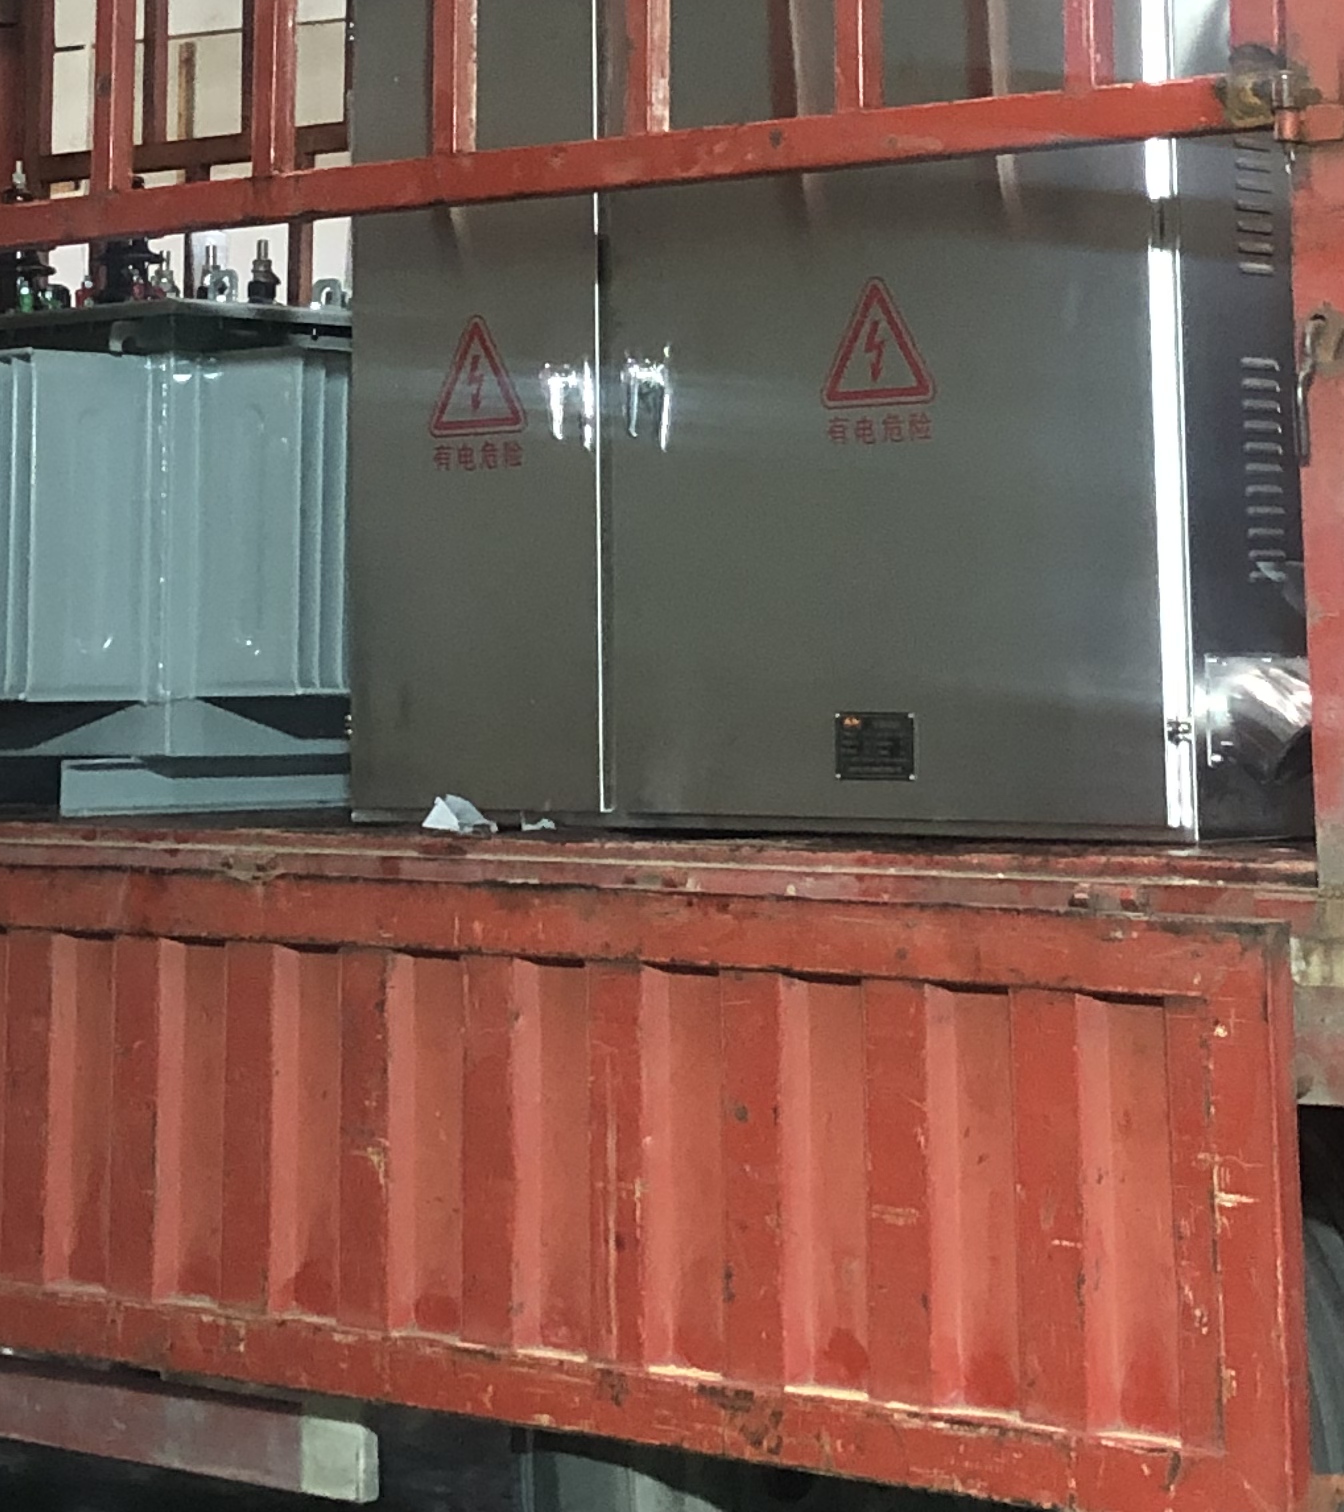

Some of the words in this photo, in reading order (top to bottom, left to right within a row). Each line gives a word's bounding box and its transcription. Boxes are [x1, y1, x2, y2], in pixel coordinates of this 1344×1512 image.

[828, 412, 933, 444] 有电危险
[433, 440, 524, 471] 有电危险
